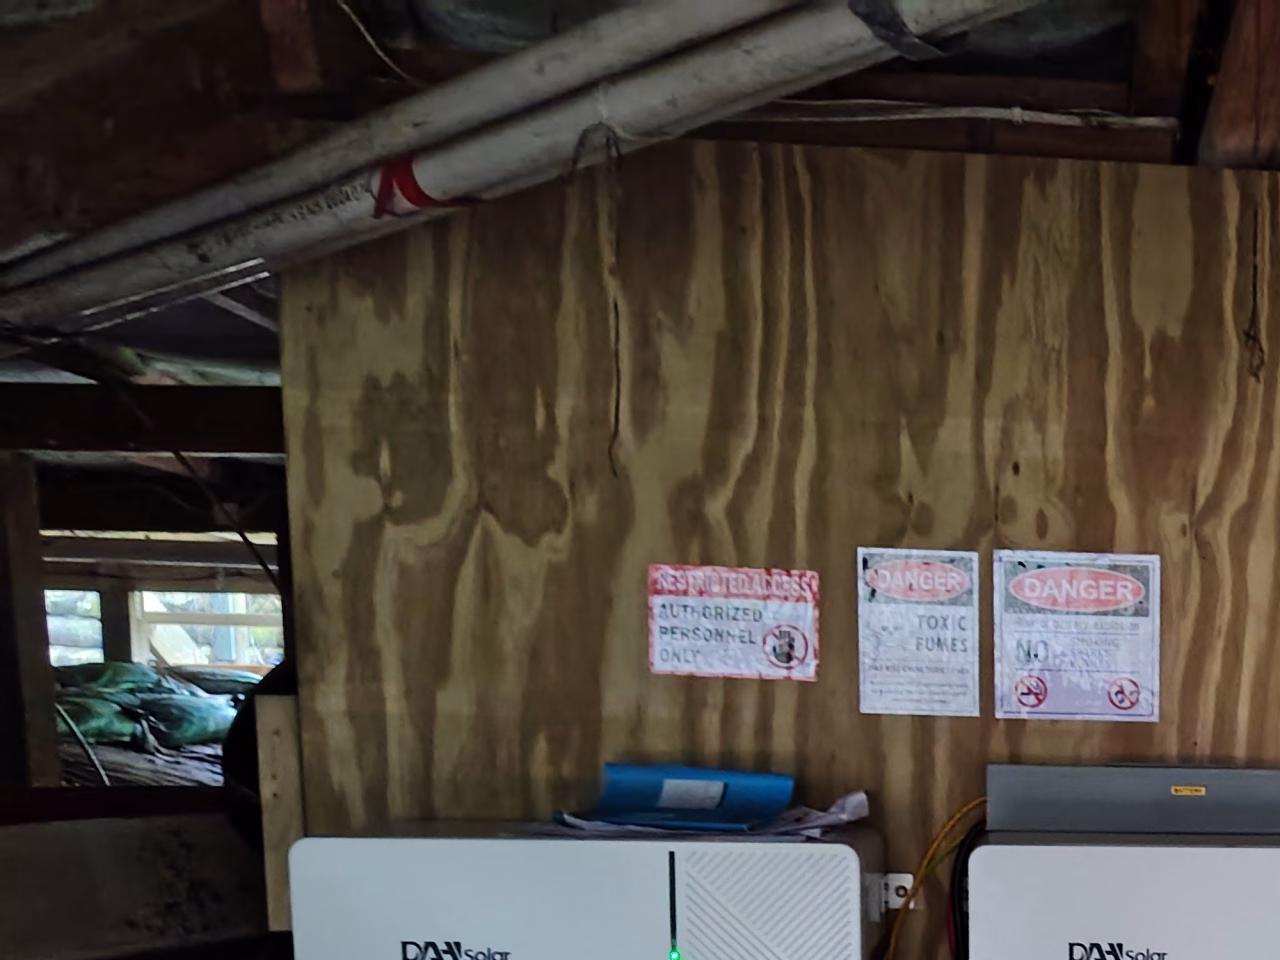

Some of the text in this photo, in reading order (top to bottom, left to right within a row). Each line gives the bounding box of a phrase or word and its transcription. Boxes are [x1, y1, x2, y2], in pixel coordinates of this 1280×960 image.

[876, 569, 962, 591] DANGER
[1022, 577, 1133, 601] DANGER
[658, 603, 763, 623] AUTHORIZED
[916, 615, 968, 632] TOXIC
[658, 626, 757, 645] PERSONNEL
[916, 637, 969, 653] FUMES
[659, 648, 701, 664] ONLY
[1015, 639, 1049, 663] NO
